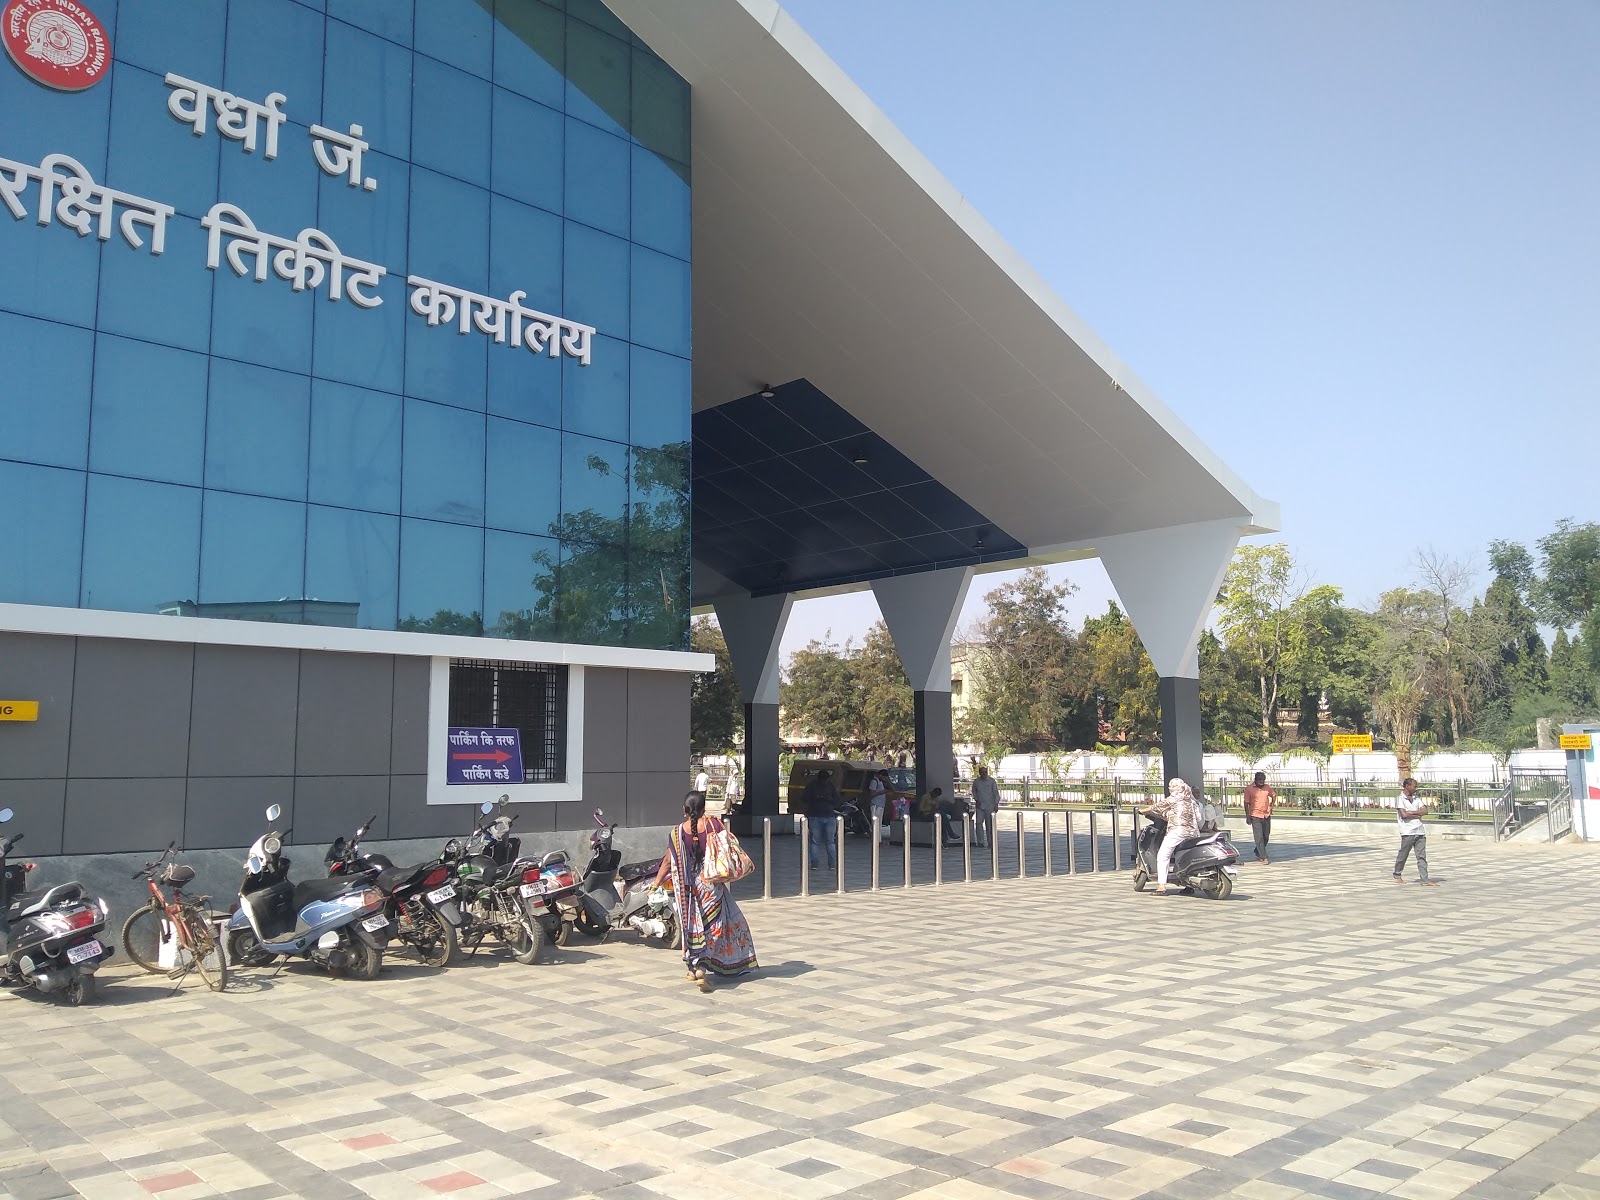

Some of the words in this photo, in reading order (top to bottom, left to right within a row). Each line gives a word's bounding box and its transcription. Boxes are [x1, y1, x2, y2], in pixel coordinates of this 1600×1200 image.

[10, 4, 28, 38] भारतीय
[55, 0, 94, 27] INDIAN
[86, 28, 105, 76] RAILWAYS
[164, 72, 287, 159] वर्धा
[201, 202, 387, 308] तिकीट
[408, 273, 596, 365] कार्यालय
[480, 731, 494, 746] कि
[495, 735, 515, 746] तरफ
[493, 765, 510, 780] कडे
